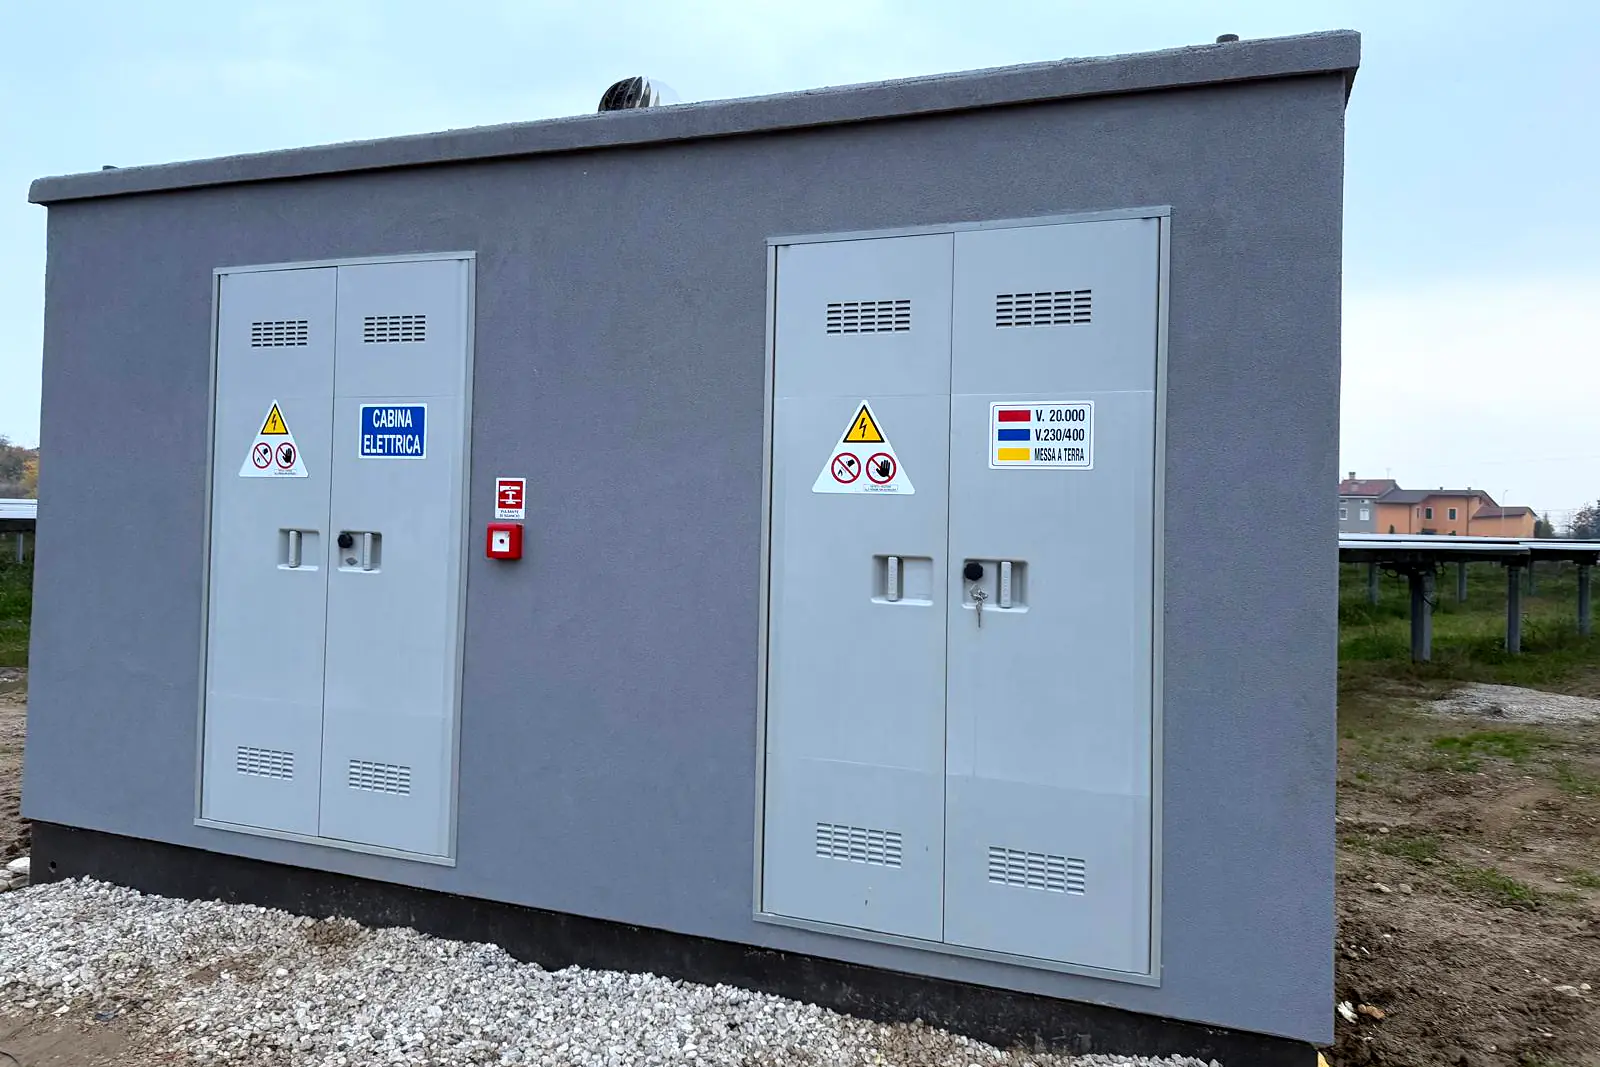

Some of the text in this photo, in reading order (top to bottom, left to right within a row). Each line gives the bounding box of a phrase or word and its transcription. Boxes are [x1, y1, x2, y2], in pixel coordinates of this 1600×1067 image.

[373, 409, 413, 428] CABINA
[1035, 409, 1085, 422] V. 20.000
[1035, 428, 1085, 442] V.230/400
[363, 434, 421, 454] ELETTRICA
[1034, 447, 1085, 461] MESSA A TERRA
